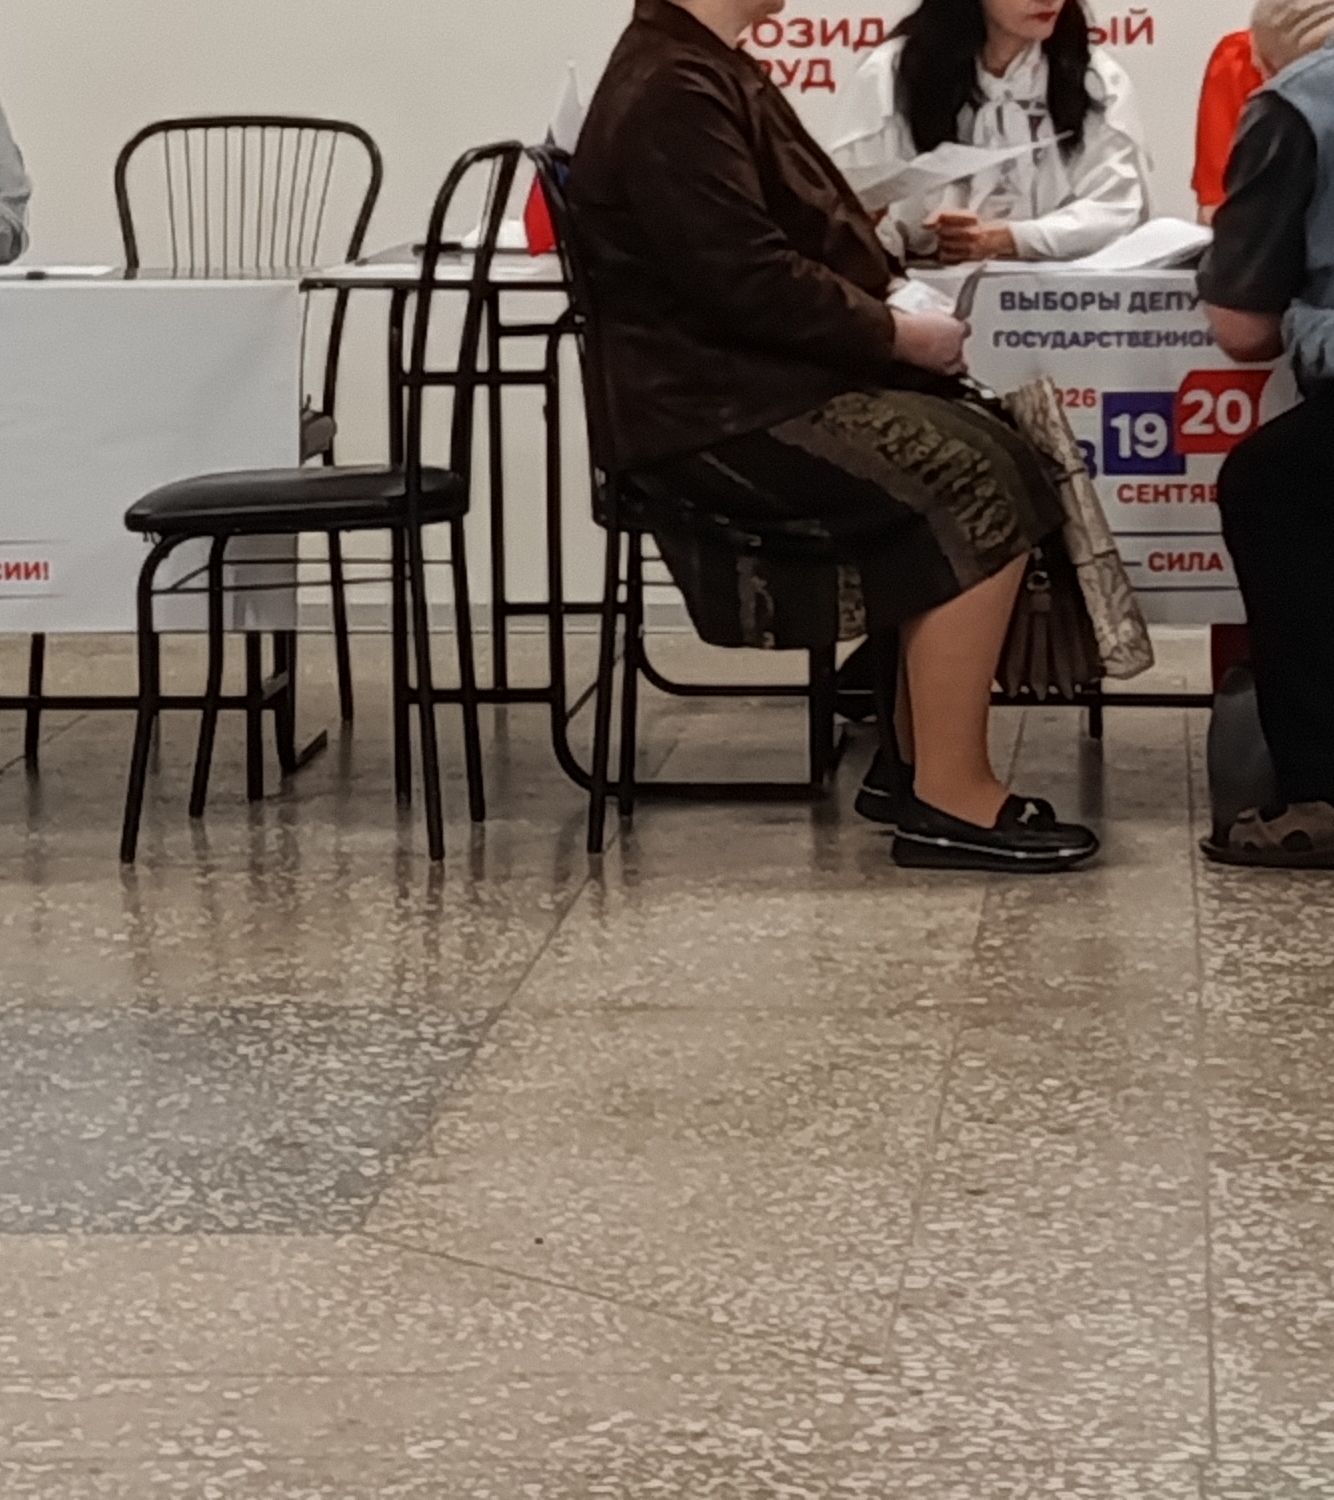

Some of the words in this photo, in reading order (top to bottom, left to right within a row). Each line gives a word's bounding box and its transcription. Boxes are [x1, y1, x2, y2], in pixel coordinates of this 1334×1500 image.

[1000, 291, 1120, 311] ВЫБОРЫ
[1109, 412, 1167, 459] 19
[1182, 390, 1252, 435] 20
[1148, 552, 1223, 572] СИЛА
